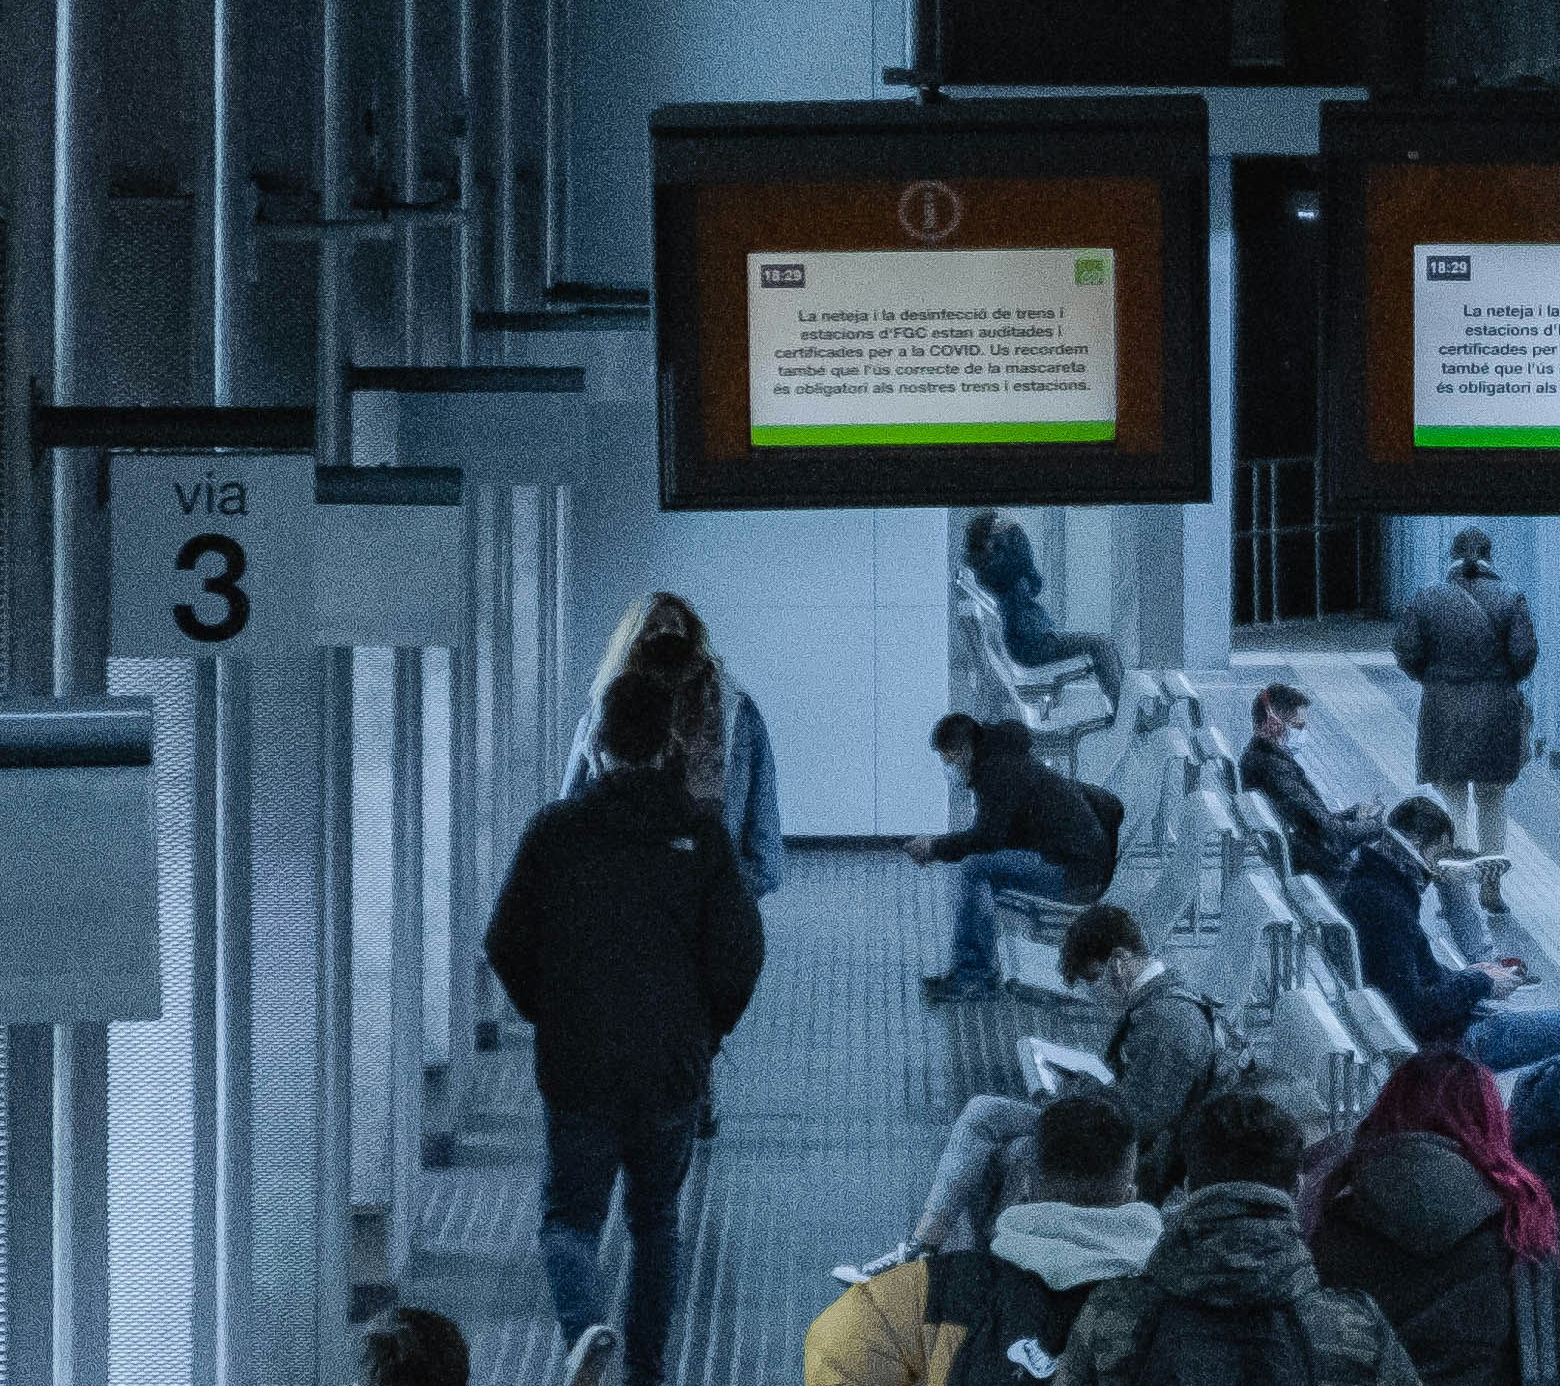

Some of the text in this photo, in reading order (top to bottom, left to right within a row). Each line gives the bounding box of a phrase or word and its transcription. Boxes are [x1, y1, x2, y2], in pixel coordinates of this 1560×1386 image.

[1429, 261, 1468, 275] 18:29
[763, 269, 803, 283] 18:29
[798, 310, 818, 323] La
[821, 310, 869, 324] neteja
[882, 310, 895, 321] la
[899, 309, 988, 321] desinfecció
[992, 308, 1012, 320] de
[1015, 308, 1055, 319] trens
[1463, 305, 1482, 318] La
[1486, 306, 1534, 320] neteja
[1547, 305, 1560, 317] la
[800, 329, 874, 341] estacions
[879, 327, 927, 339] d'FGC
[931, 328, 974, 339] estan
[978, 326, 1054, 338] auditades
[1465, 324, 1539, 336] estacions
[774, 346, 864, 359] certificades
[868, 348, 893, 360] per
[911, 345, 925, 357] la
[929, 344, 984, 357] COVID.
[990, 344, 1010, 356] Us
[1014, 344, 1089, 356] recordem
[1438, 343, 1527, 356] certificades
[1532, 346, 1557, 358] per
[778, 365, 826, 377] també
[830, 367, 860, 378] que
[895, 364, 960, 376] correcte
[964, 363, 983, 375] de
[988, 363, 1001, 374] la
[1005, 361, 1086, 374] mascareta
[1441, 363, 1489, 375] també
[1494, 365, 1523, 377] que
[1527, 363, 1554, 375] l'ús
[773, 384, 791, 395] és
[795, 383, 868, 397] obligatori
[873, 382, 894, 394] als
[899, 382, 956, 393] nostres
[960, 382, 1000, 393] trens
[1013, 381, 1090, 392] estacions.
[1436, 382, 1454, 394] és
[1458, 381, 1531, 396] obligatori
[1536, 382, 1557, 394] als
[173, 471, 248, 516] via
[172, 532, 251, 644] 3
